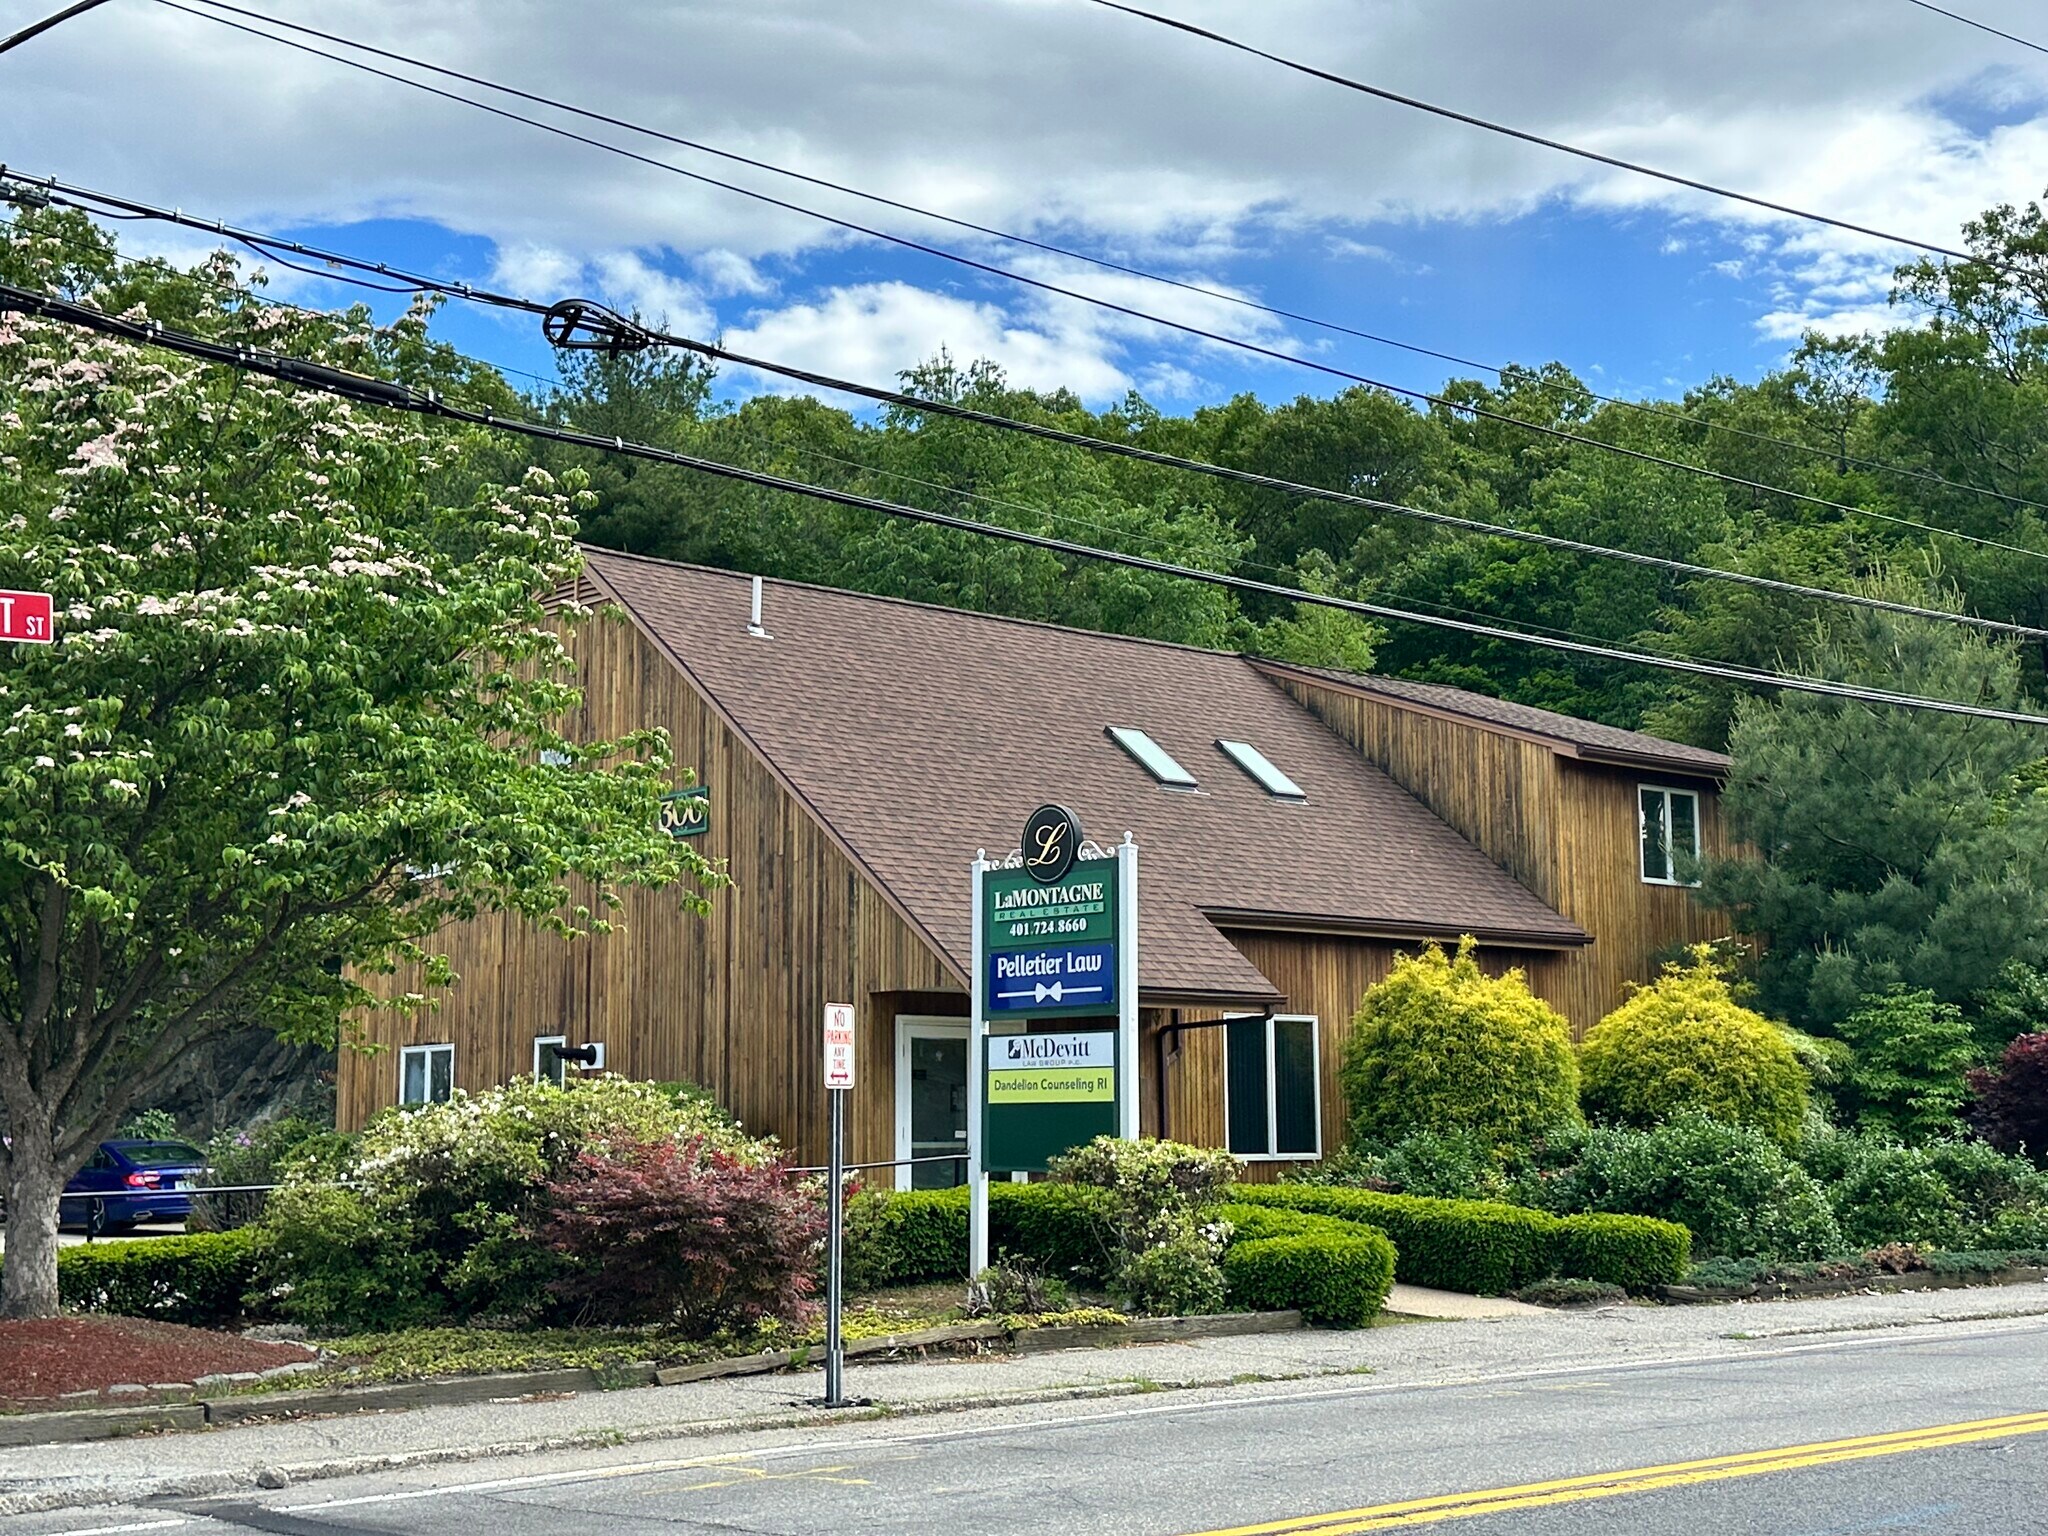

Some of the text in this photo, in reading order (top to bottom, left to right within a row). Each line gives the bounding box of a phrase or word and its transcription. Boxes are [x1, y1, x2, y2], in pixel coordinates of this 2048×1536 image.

[26, 615, 44, 636] ST
[994, 883, 1104, 909] LaMONTAGNE
[1000, 904, 1099, 920] REAL ESTATE
[1009, 918, 1087, 936] 401.724.8660
[997, 952, 1102, 978] Pelletier Law
[834, 1012, 846, 1027] NO
[826, 1030, 852, 1045] PARKING
[834, 1047, 845, 1057] ANY
[1021, 1036, 1091, 1058] McDevitt
[833, 1059, 846, 1069] TIME
[994, 1078, 1107, 1093] Dandelion Counseling RI
